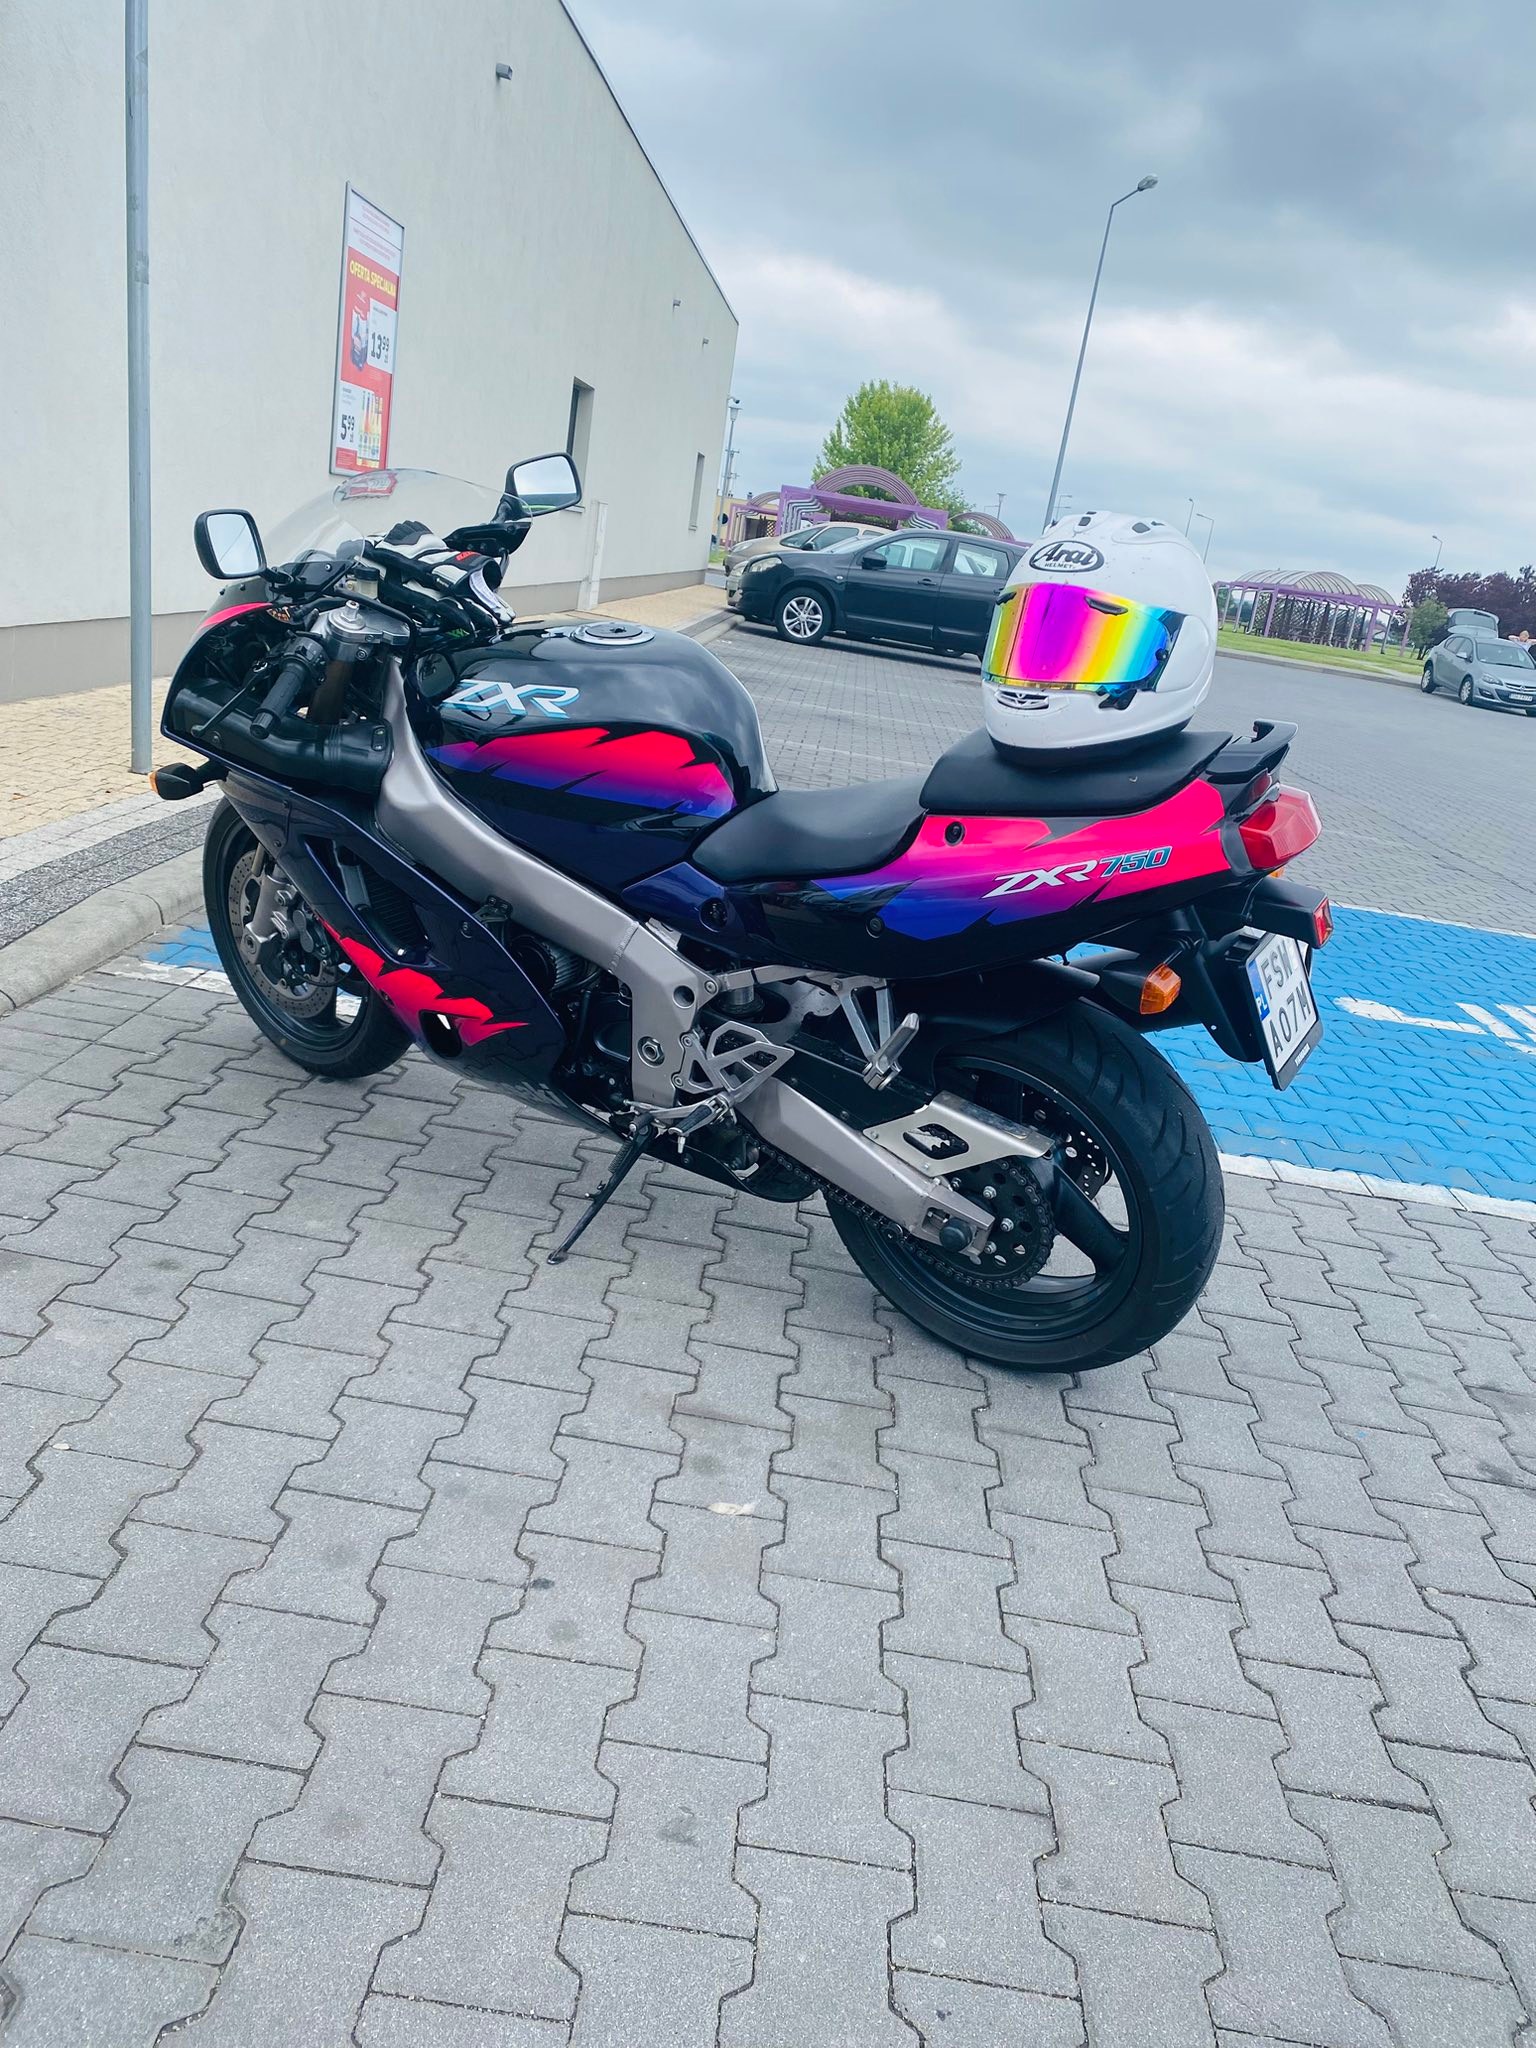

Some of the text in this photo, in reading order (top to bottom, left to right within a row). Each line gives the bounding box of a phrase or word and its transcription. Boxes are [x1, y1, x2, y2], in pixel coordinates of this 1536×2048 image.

[350, 260, 370, 283] OFERTA
[1032, 543, 1096, 566] Arai
[441, 678, 581, 719] ZXR
[981, 845, 1173, 899] ZXR 750
[1256, 993, 1268, 1016] PL
